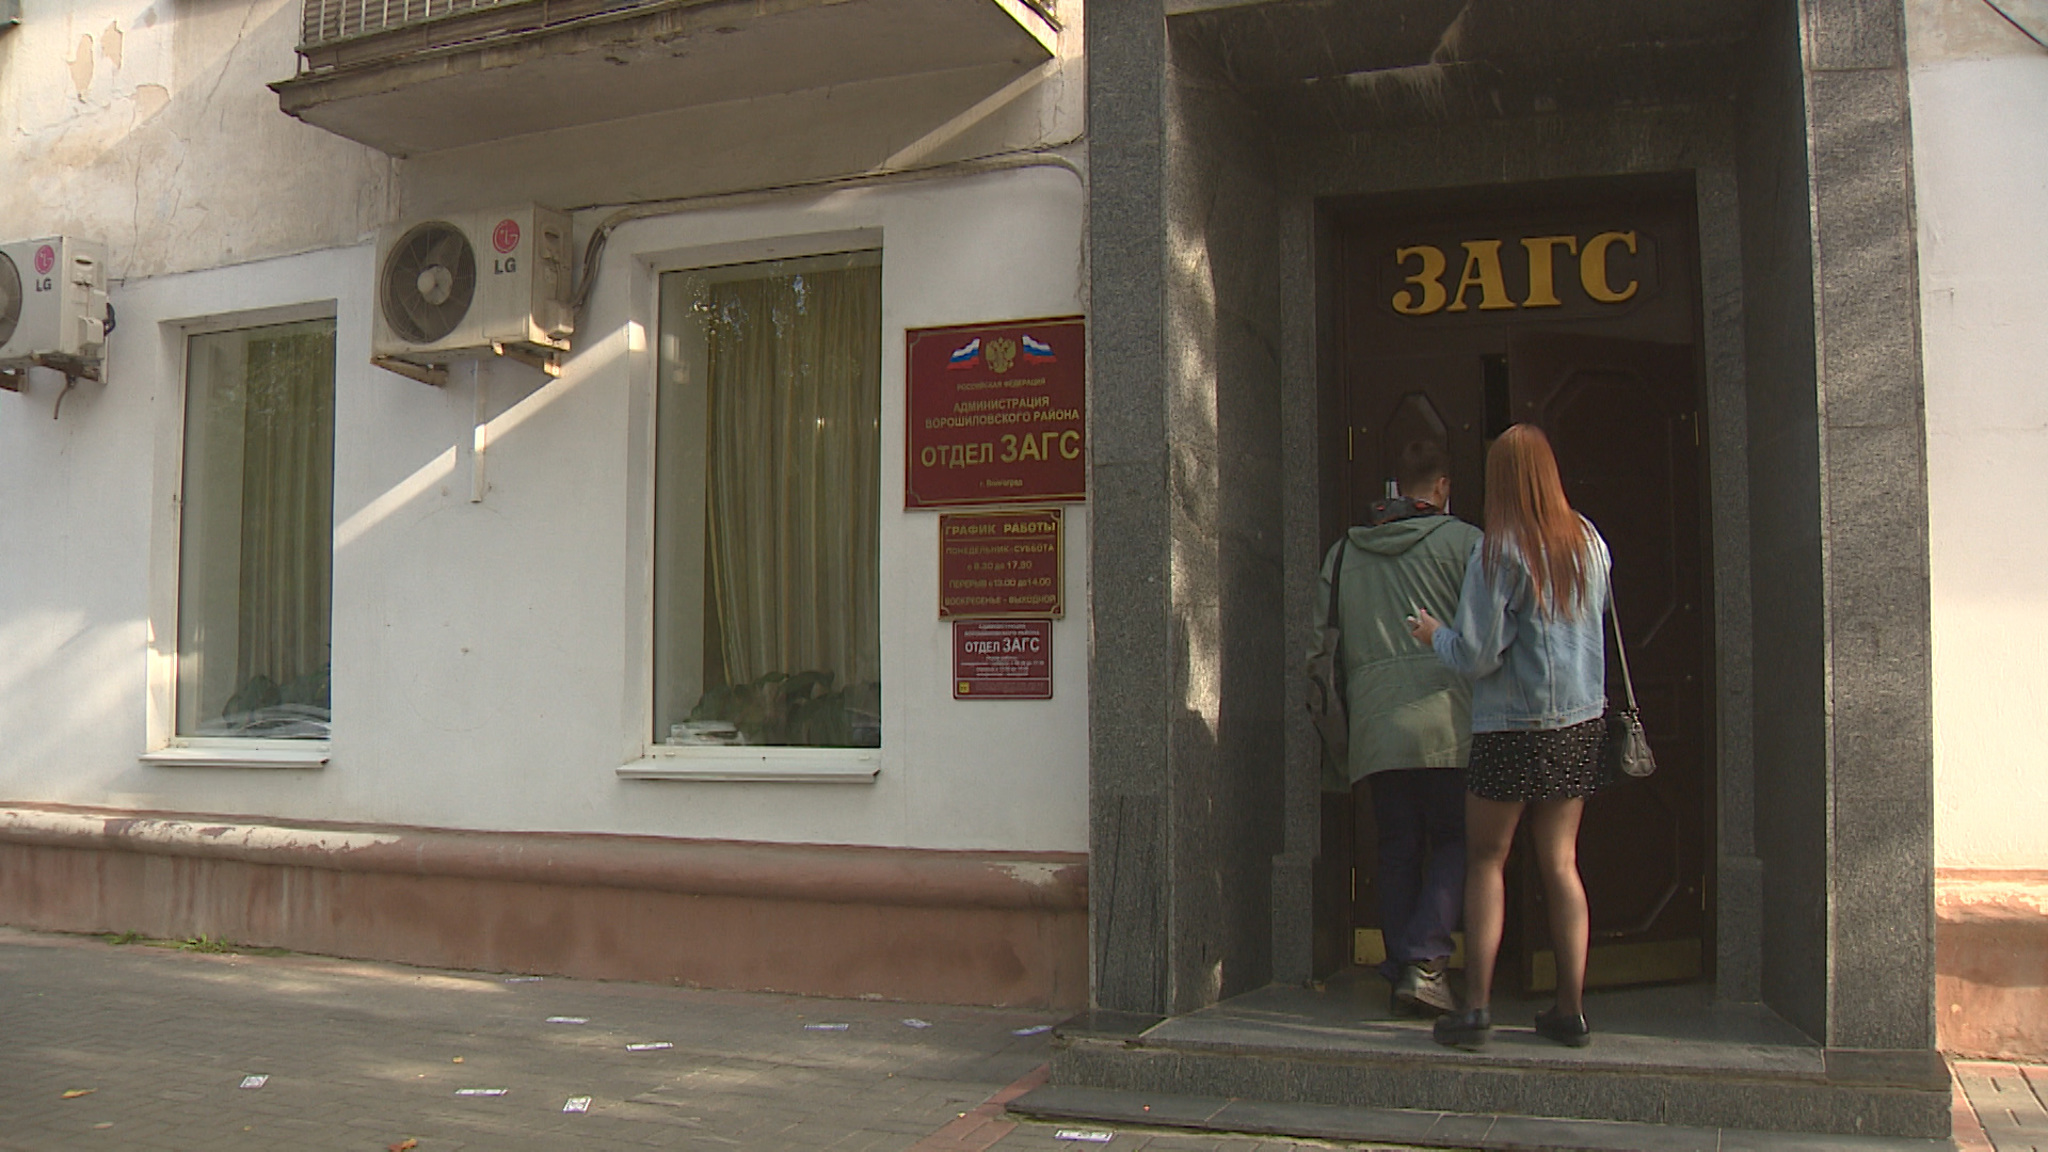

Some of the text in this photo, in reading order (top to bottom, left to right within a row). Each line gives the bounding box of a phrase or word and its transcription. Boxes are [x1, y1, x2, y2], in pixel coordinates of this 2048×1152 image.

[493, 257, 516, 275] LG
[1390, 230, 1639, 316] ЗАГС
[36, 278, 51, 292] LG
[953, 396, 1050, 413] АДМИНИСТРАЦИЯ
[925, 408, 1079, 429] ВОРОШИЛОВСКОГО РАЙОНА
[921, 430, 1080, 469] ОТДЕЛ ЗАГС
[945, 522, 1055, 535] ГРАФИК РАБОТЫ
[965, 637, 1040, 654] ОТДЕЛ ЗАГС
